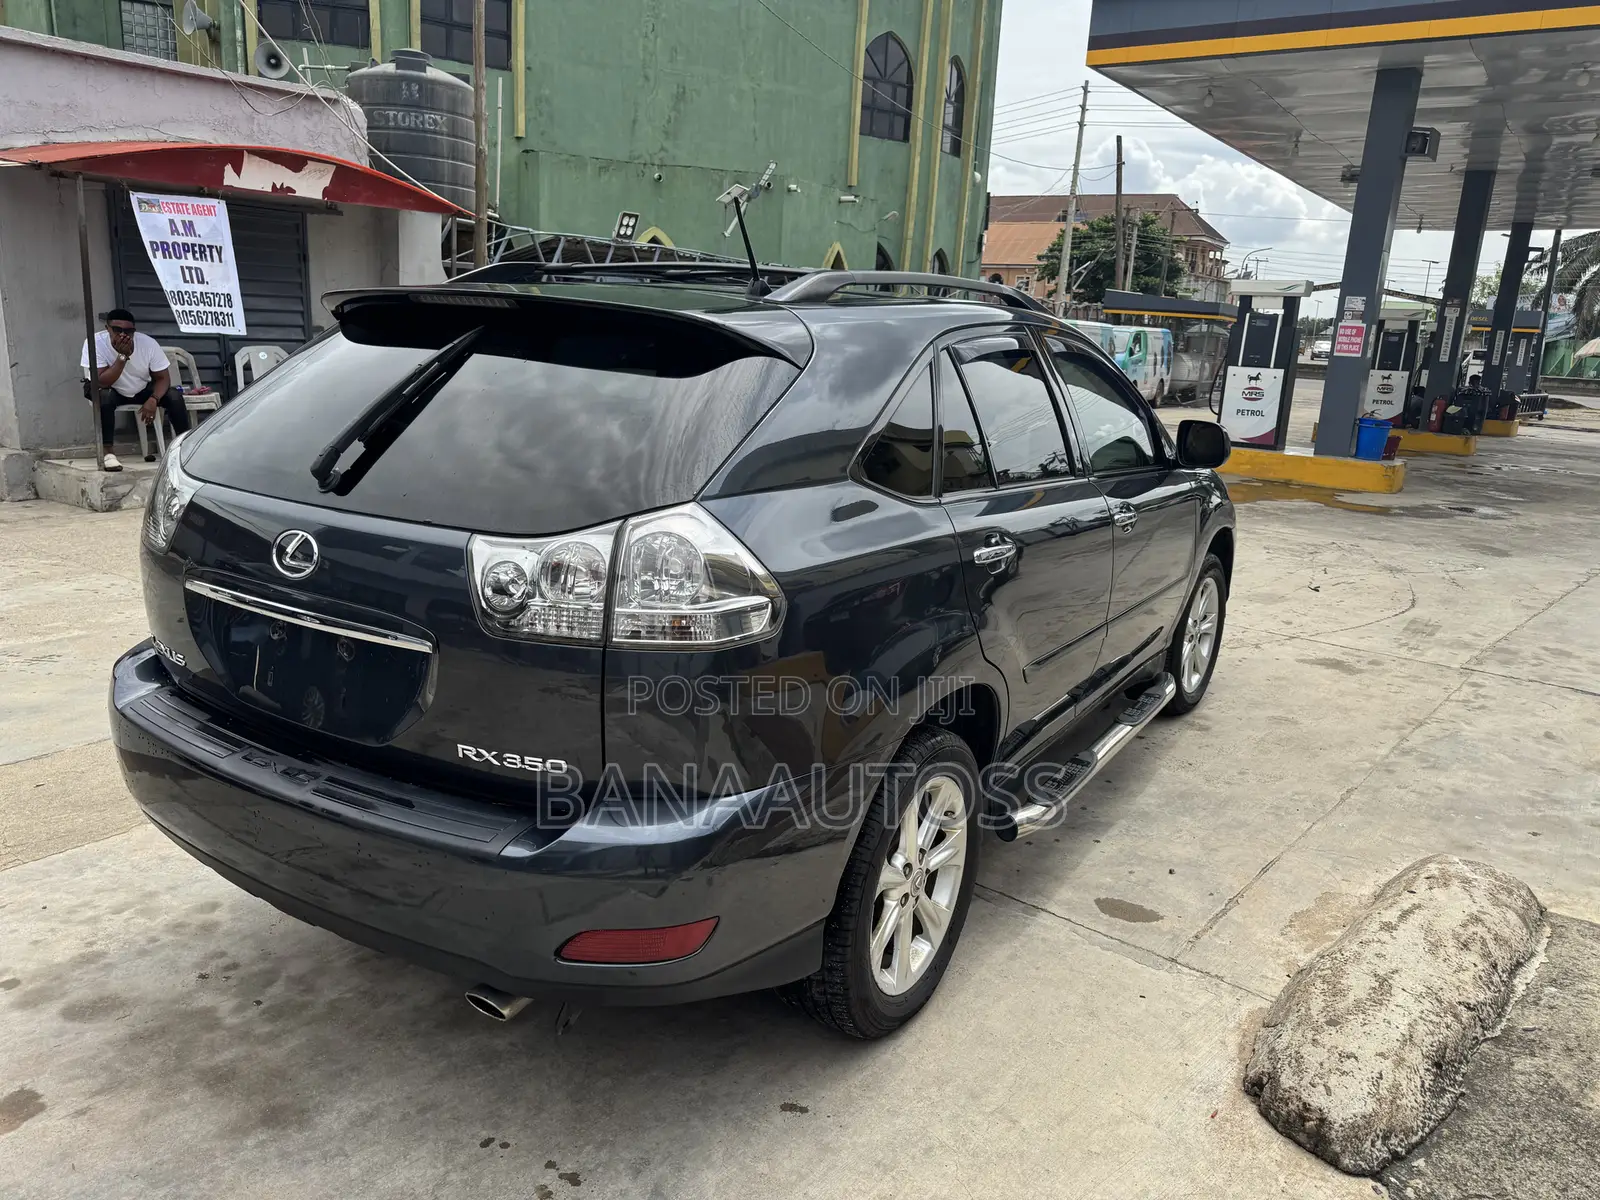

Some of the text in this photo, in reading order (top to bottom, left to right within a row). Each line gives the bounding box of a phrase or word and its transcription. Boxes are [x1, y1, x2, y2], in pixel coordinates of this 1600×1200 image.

[373, 110, 448, 132] STOREX
[161, 201, 217, 217] ESTATE AGENT
[168, 218, 202, 238] A.M.
[149, 240, 223, 263] PROPERTY
[180, 265, 209, 285] LTD.
[1242, 390, 1265, 398] MRS
[1236, 408, 1265, 417] PETROL
[456, 743, 568, 774] RX 350
